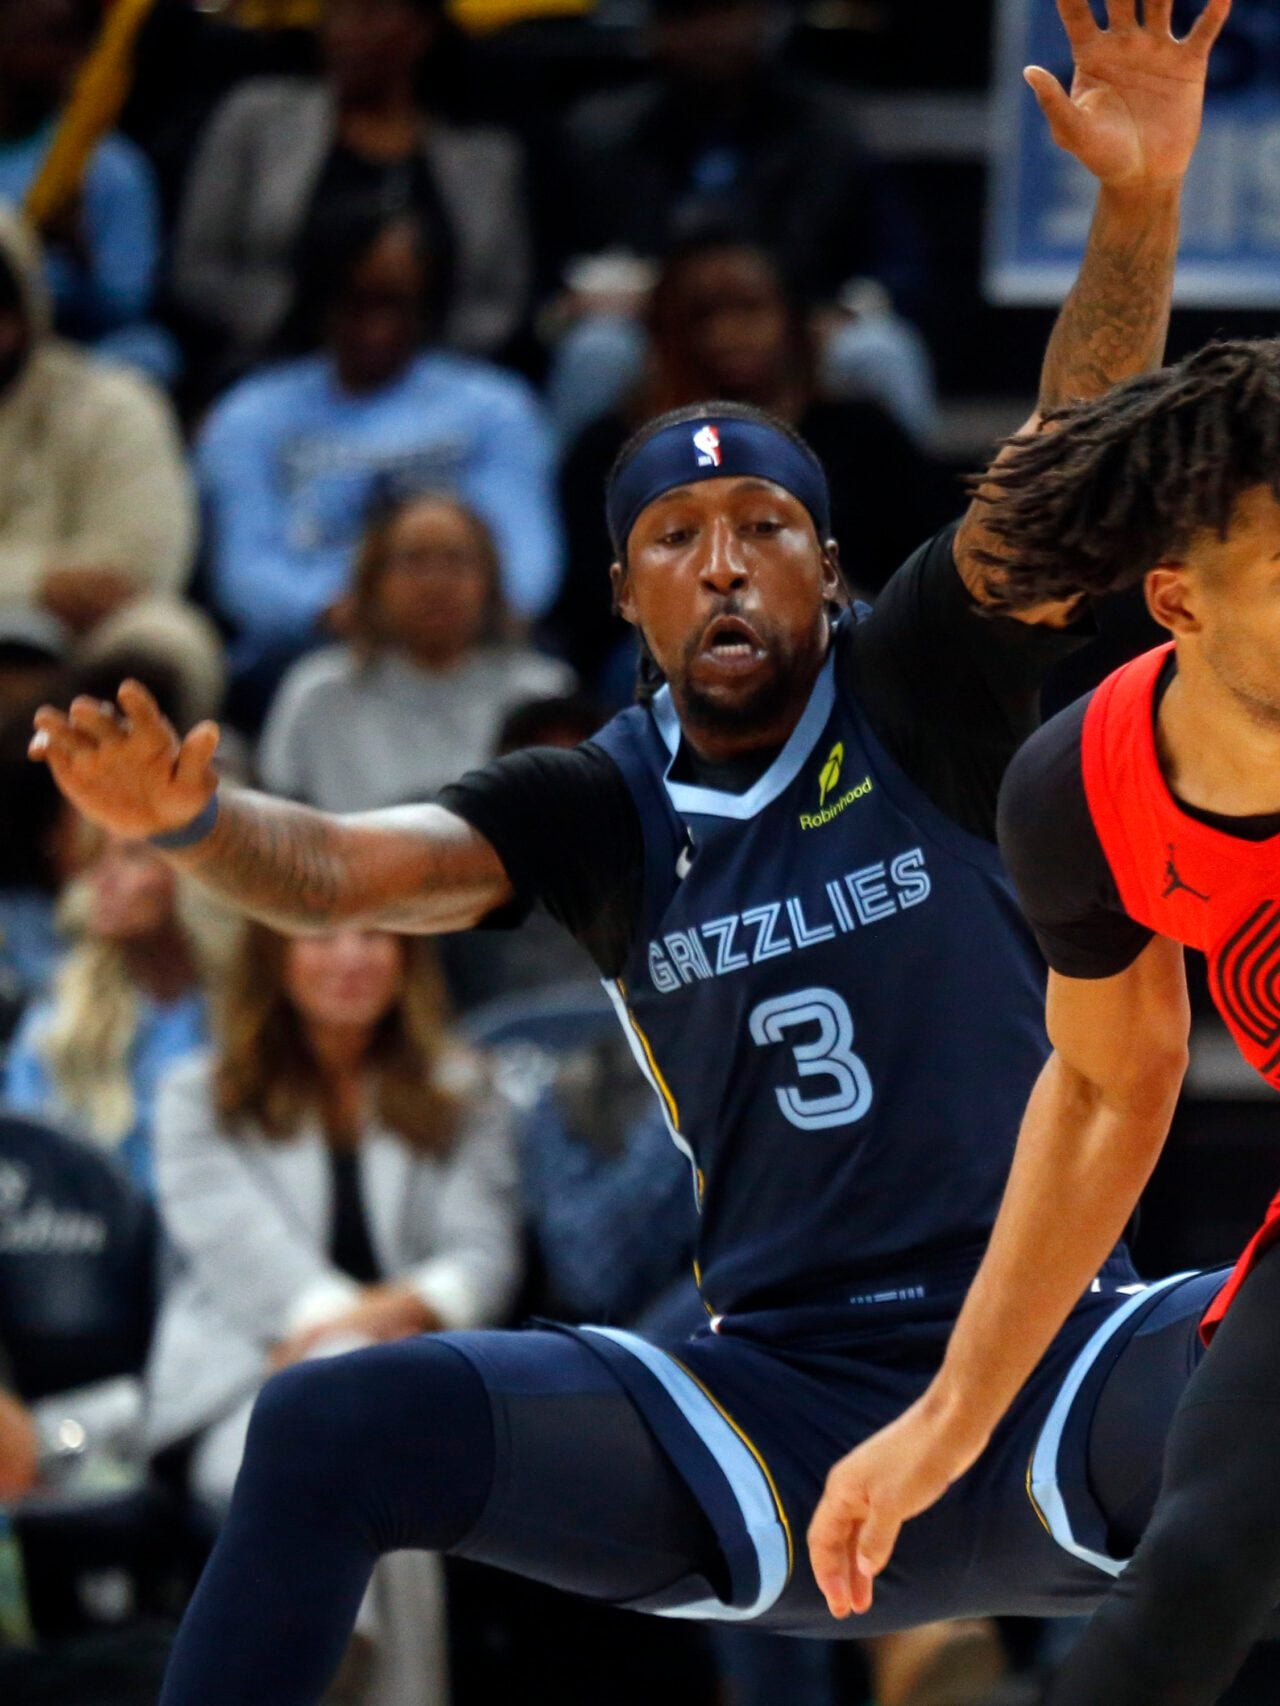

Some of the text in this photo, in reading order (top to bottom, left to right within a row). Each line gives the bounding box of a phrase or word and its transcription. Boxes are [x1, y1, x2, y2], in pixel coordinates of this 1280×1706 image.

[799, 775, 873, 831] Robinhood
[647, 847, 932, 995] GRIZZLIES
[748, 987, 873, 1131] 3
